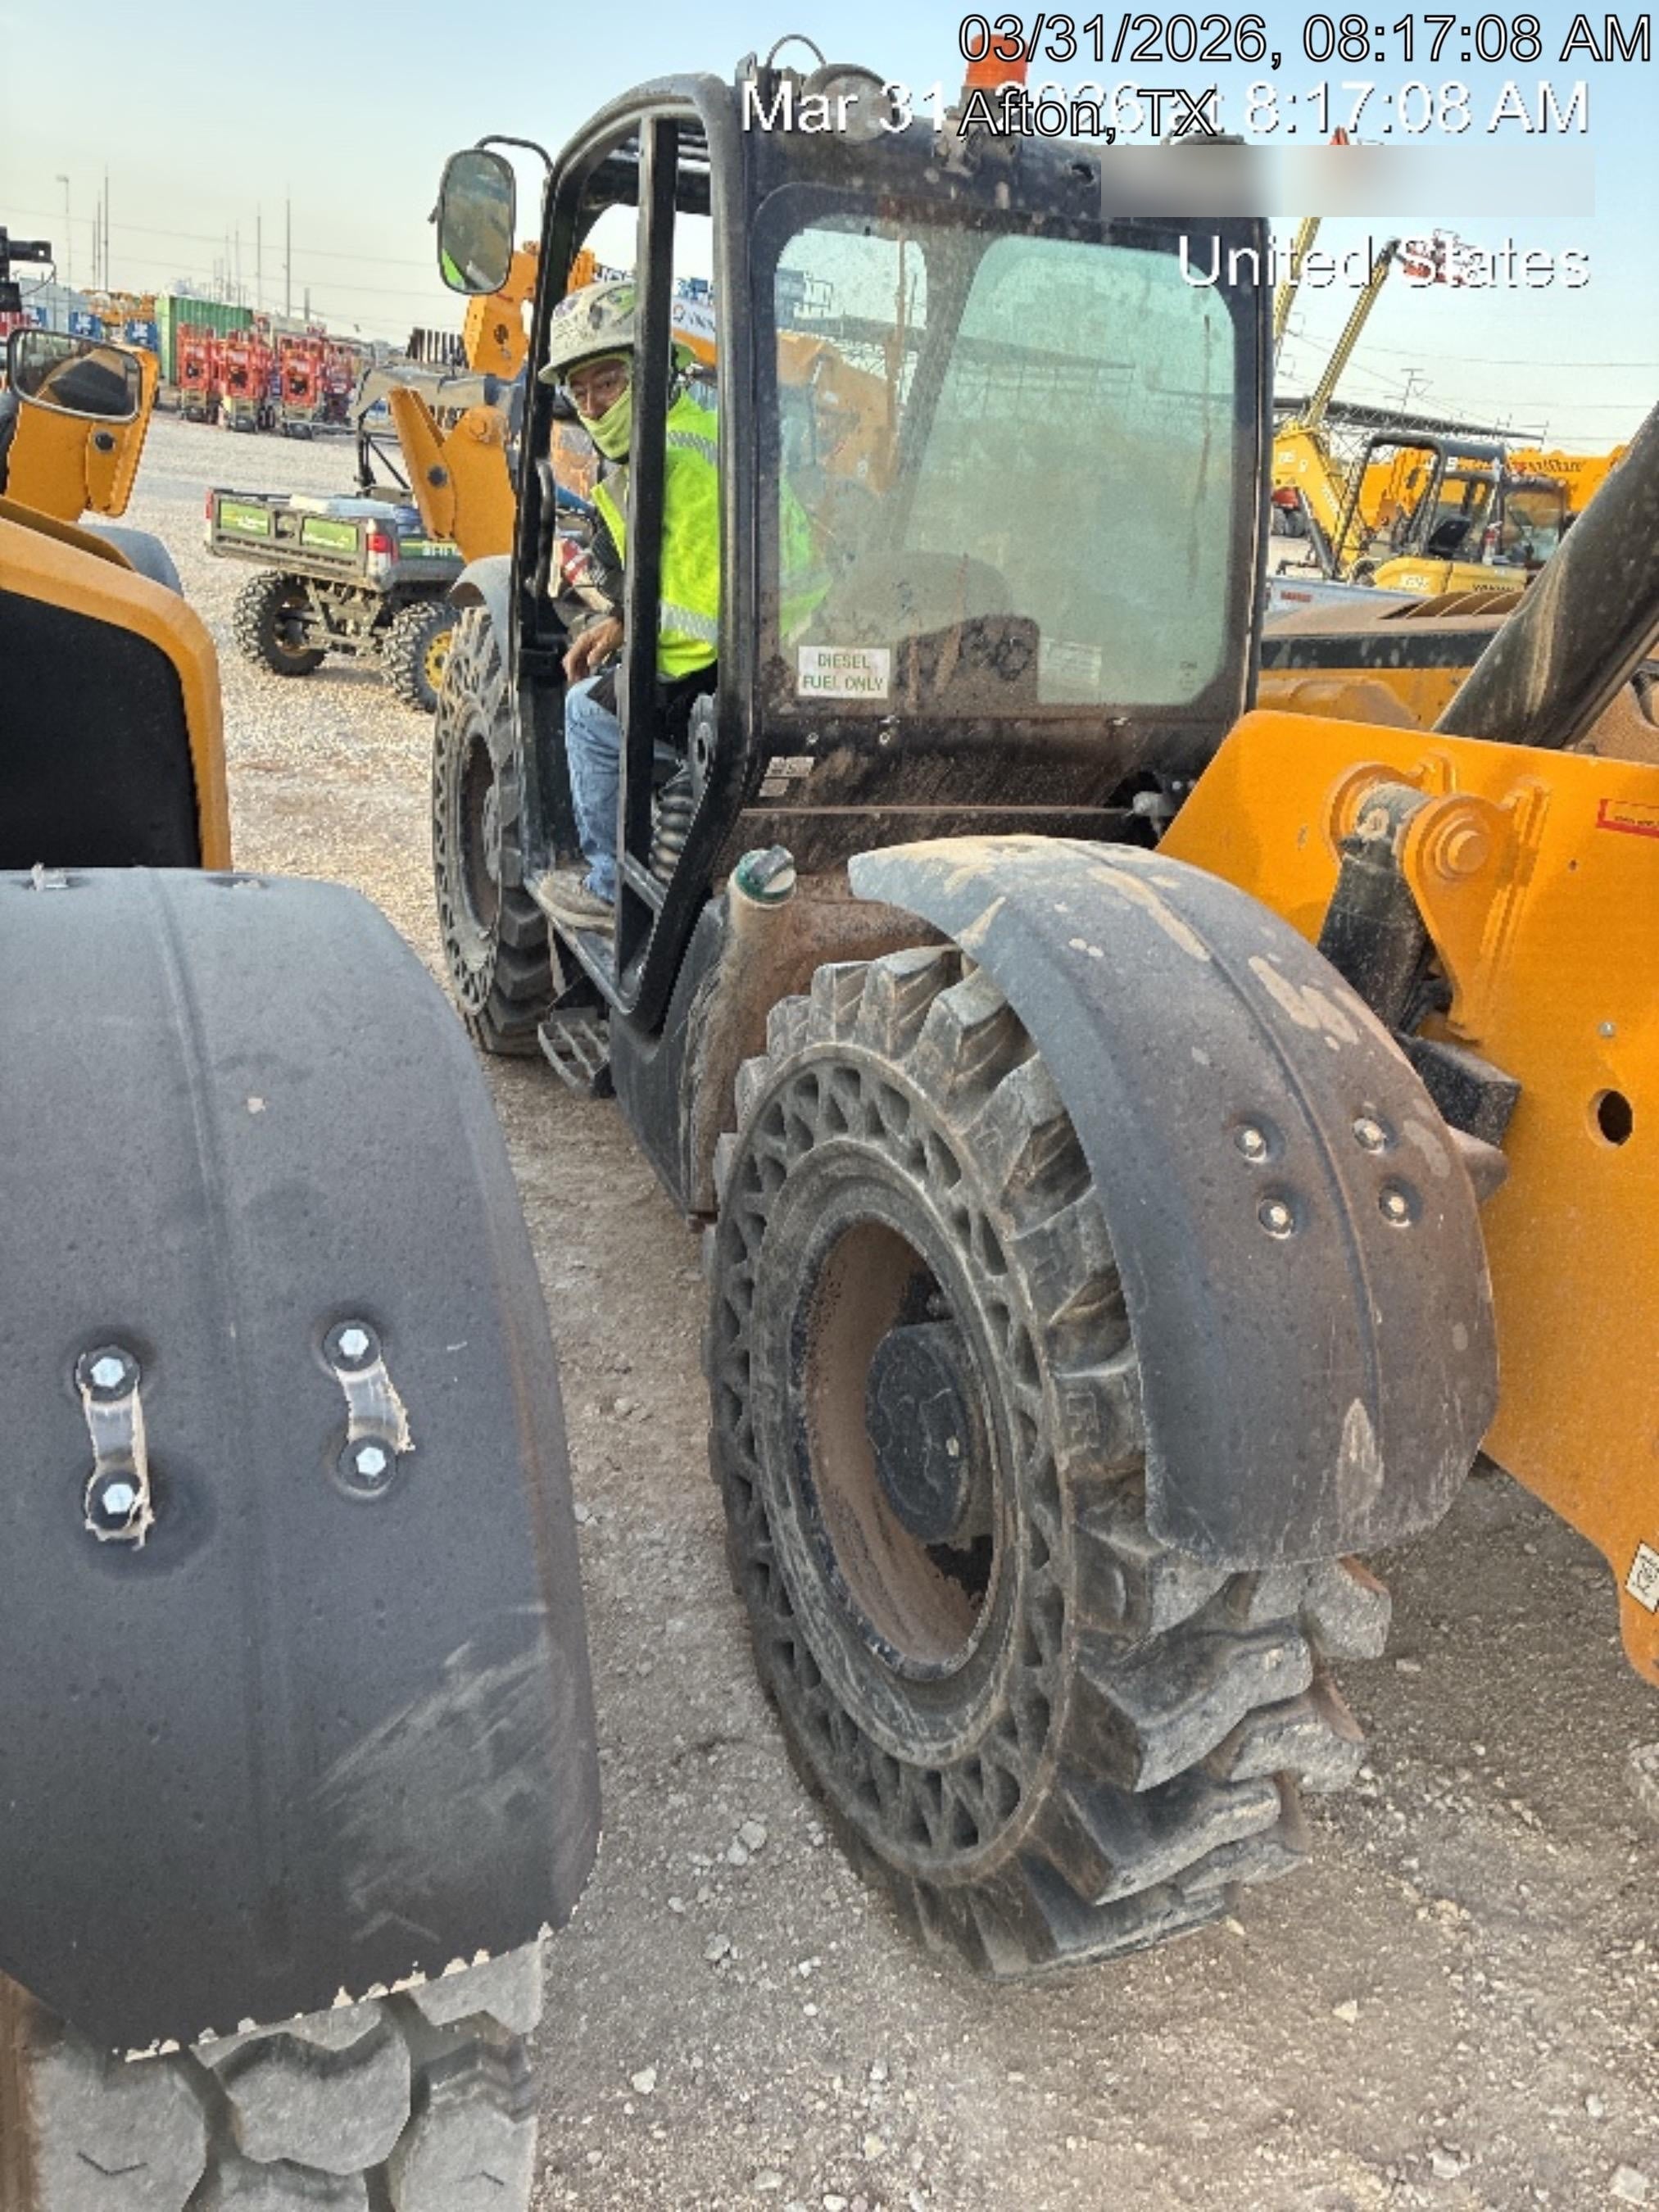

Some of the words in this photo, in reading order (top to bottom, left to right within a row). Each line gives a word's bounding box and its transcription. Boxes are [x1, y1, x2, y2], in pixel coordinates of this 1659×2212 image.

[818, 653, 872, 669] DIESEL
[803, 674, 837, 690] FUEL
[844, 675, 884, 692] ONLY
